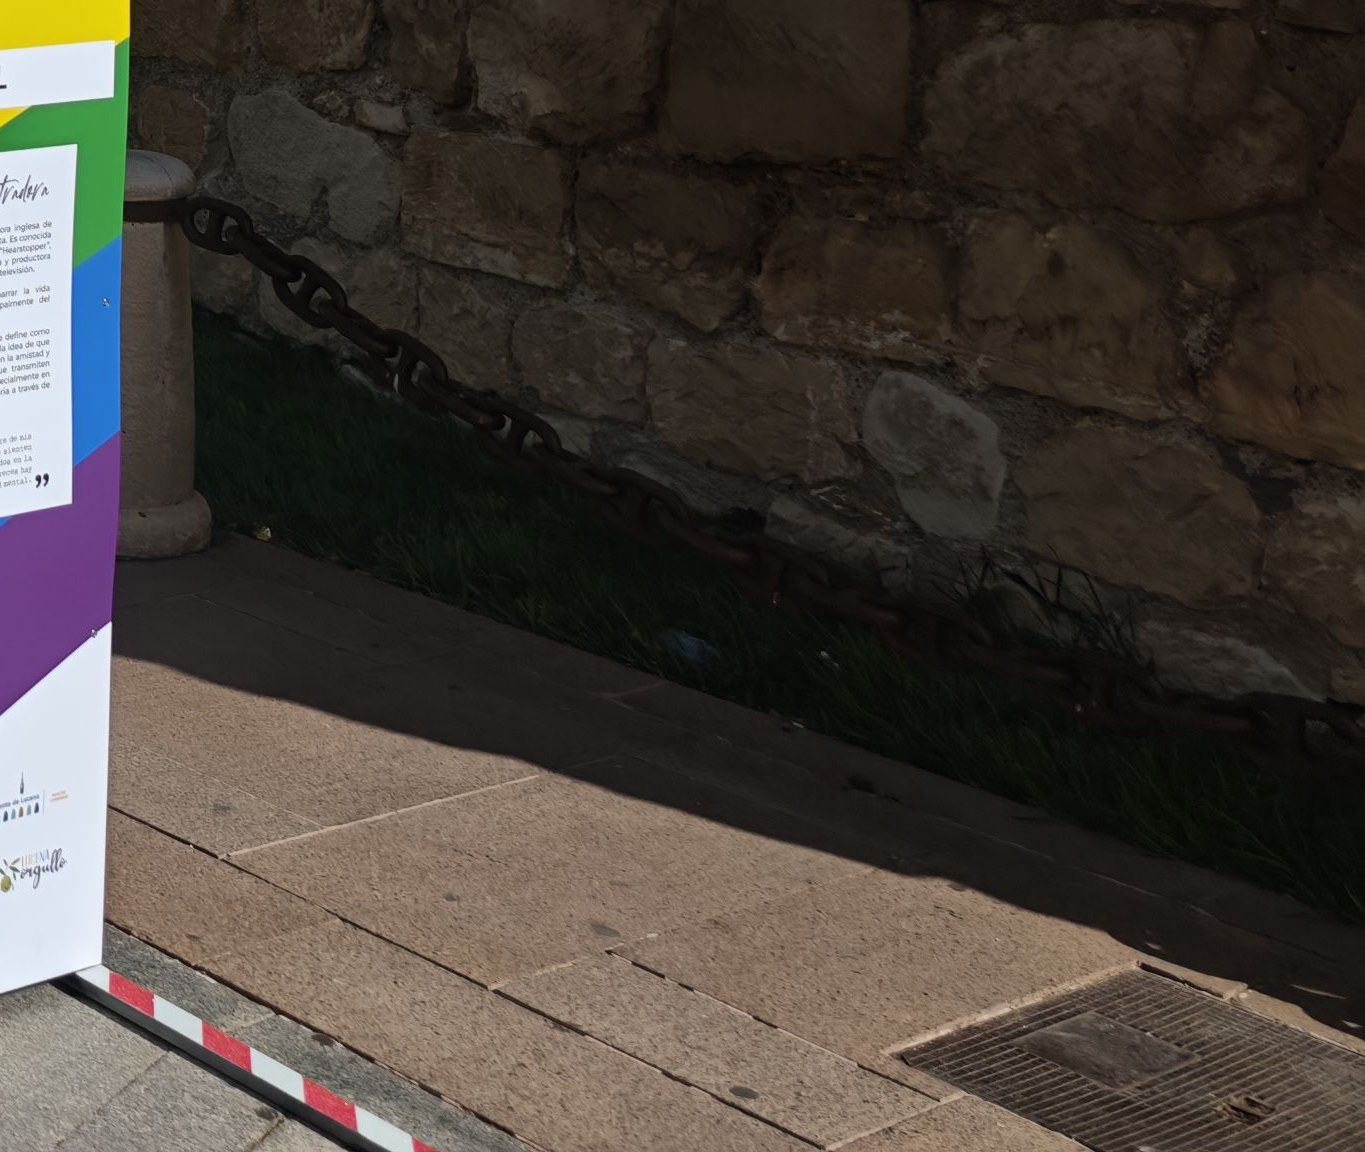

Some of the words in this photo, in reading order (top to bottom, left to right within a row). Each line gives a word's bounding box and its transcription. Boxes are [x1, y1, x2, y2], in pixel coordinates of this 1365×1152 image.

[13, 221, 39, 233] inglesa
[19, 231, 51, 242] conocida
[20, 848, 68, 889] orgullo
